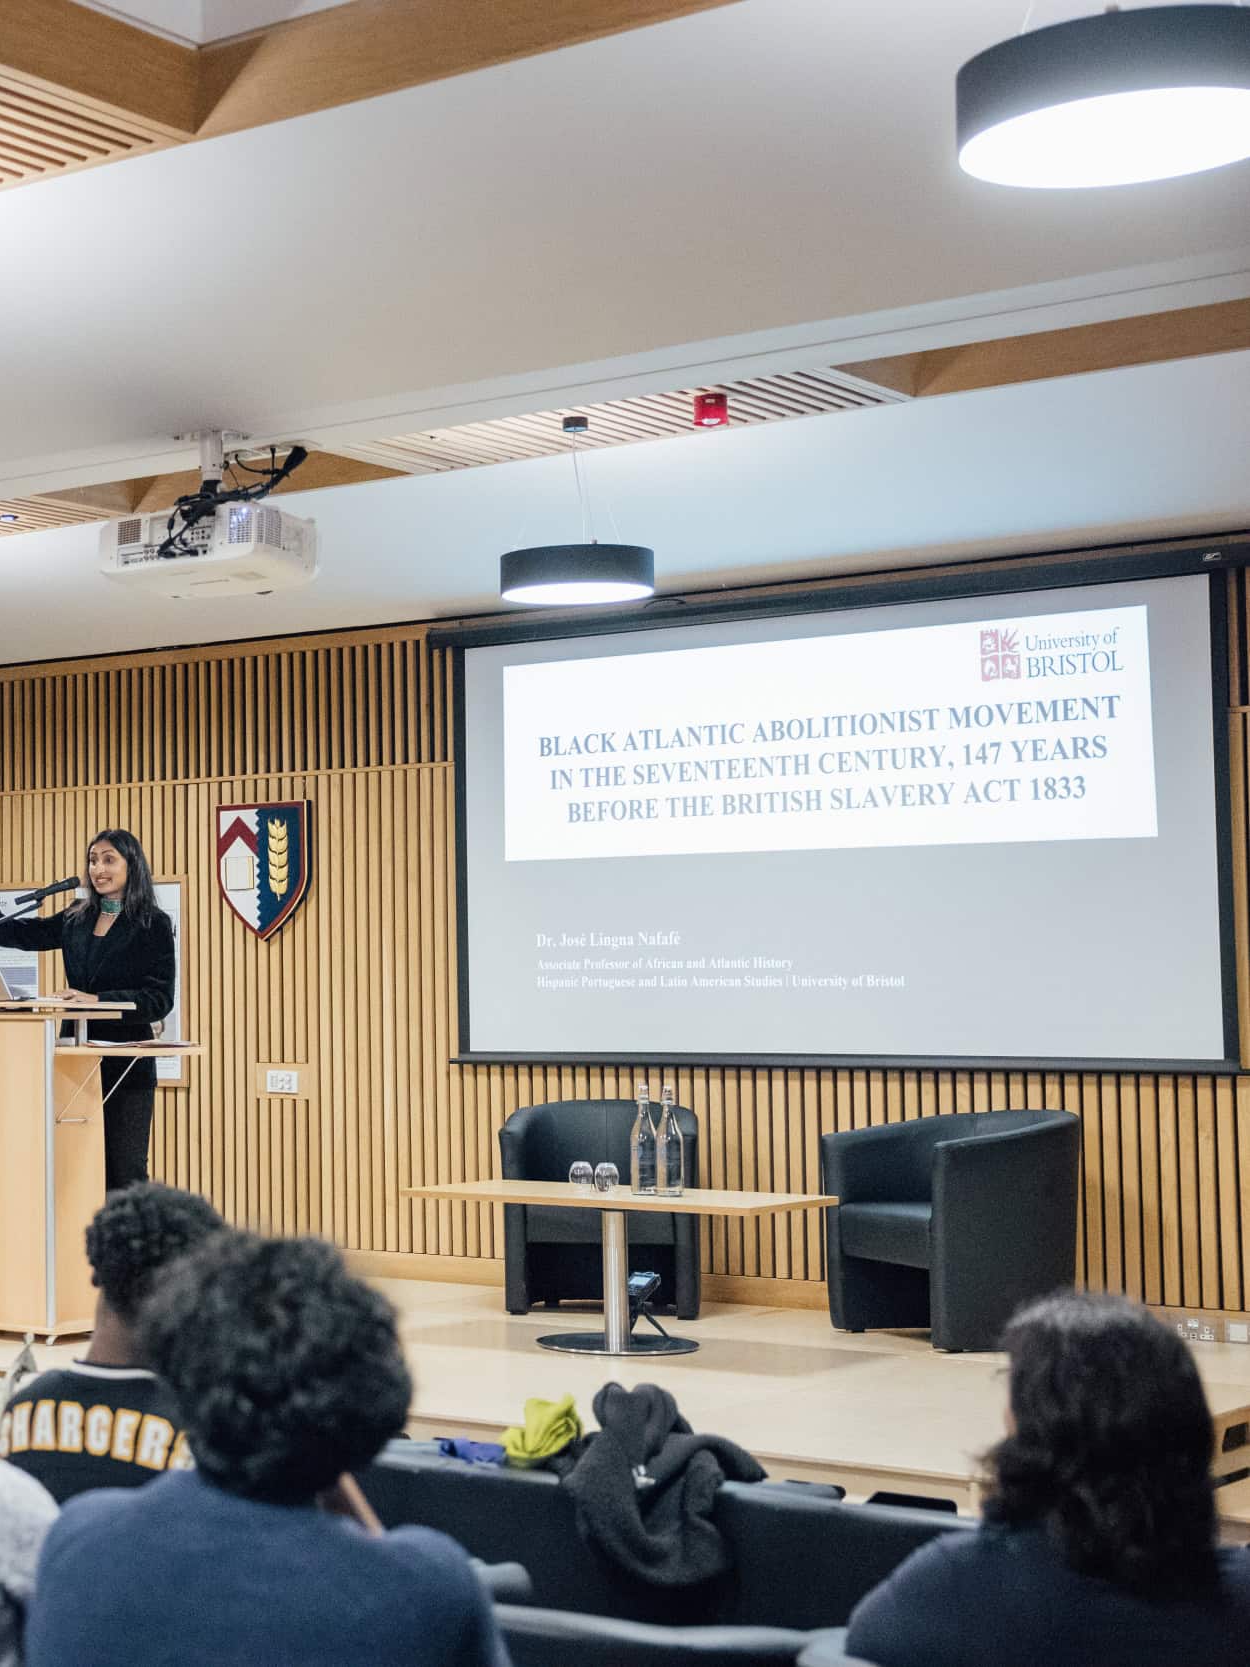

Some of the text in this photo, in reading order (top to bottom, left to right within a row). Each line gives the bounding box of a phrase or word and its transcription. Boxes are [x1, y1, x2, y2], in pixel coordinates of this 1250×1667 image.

[1025, 626, 1121, 651] University of
[1027, 650, 1124, 678] BRISTOL
[539, 695, 1120, 757] BLACK ATLANTIC ABOLITIONIST MOVEMENT
[550, 735, 1108, 790] IN THE SEVENTEENTH CENTURY, 147 YEARS
[567, 775, 1087, 823] BEFORE THE BRITISH SLAVERY ACT 1833
[559, 932, 586, 947] José
[590, 932, 634, 949] Lingna
[637, 931, 681, 946] Nafafé
[537, 956, 793, 971] Associate Professor of African and Atlantic History
[537, 975, 578, 989] Hispanic
[581, 975, 636, 989] Portuguese
[638, 975, 657, 988] and
[691, 974, 741, 988] American
[743, 974, 783, 988] Studies
[792, 974, 847, 990] University
[851, 974, 864, 987] of
[866, 973, 905, 987] Bristol
